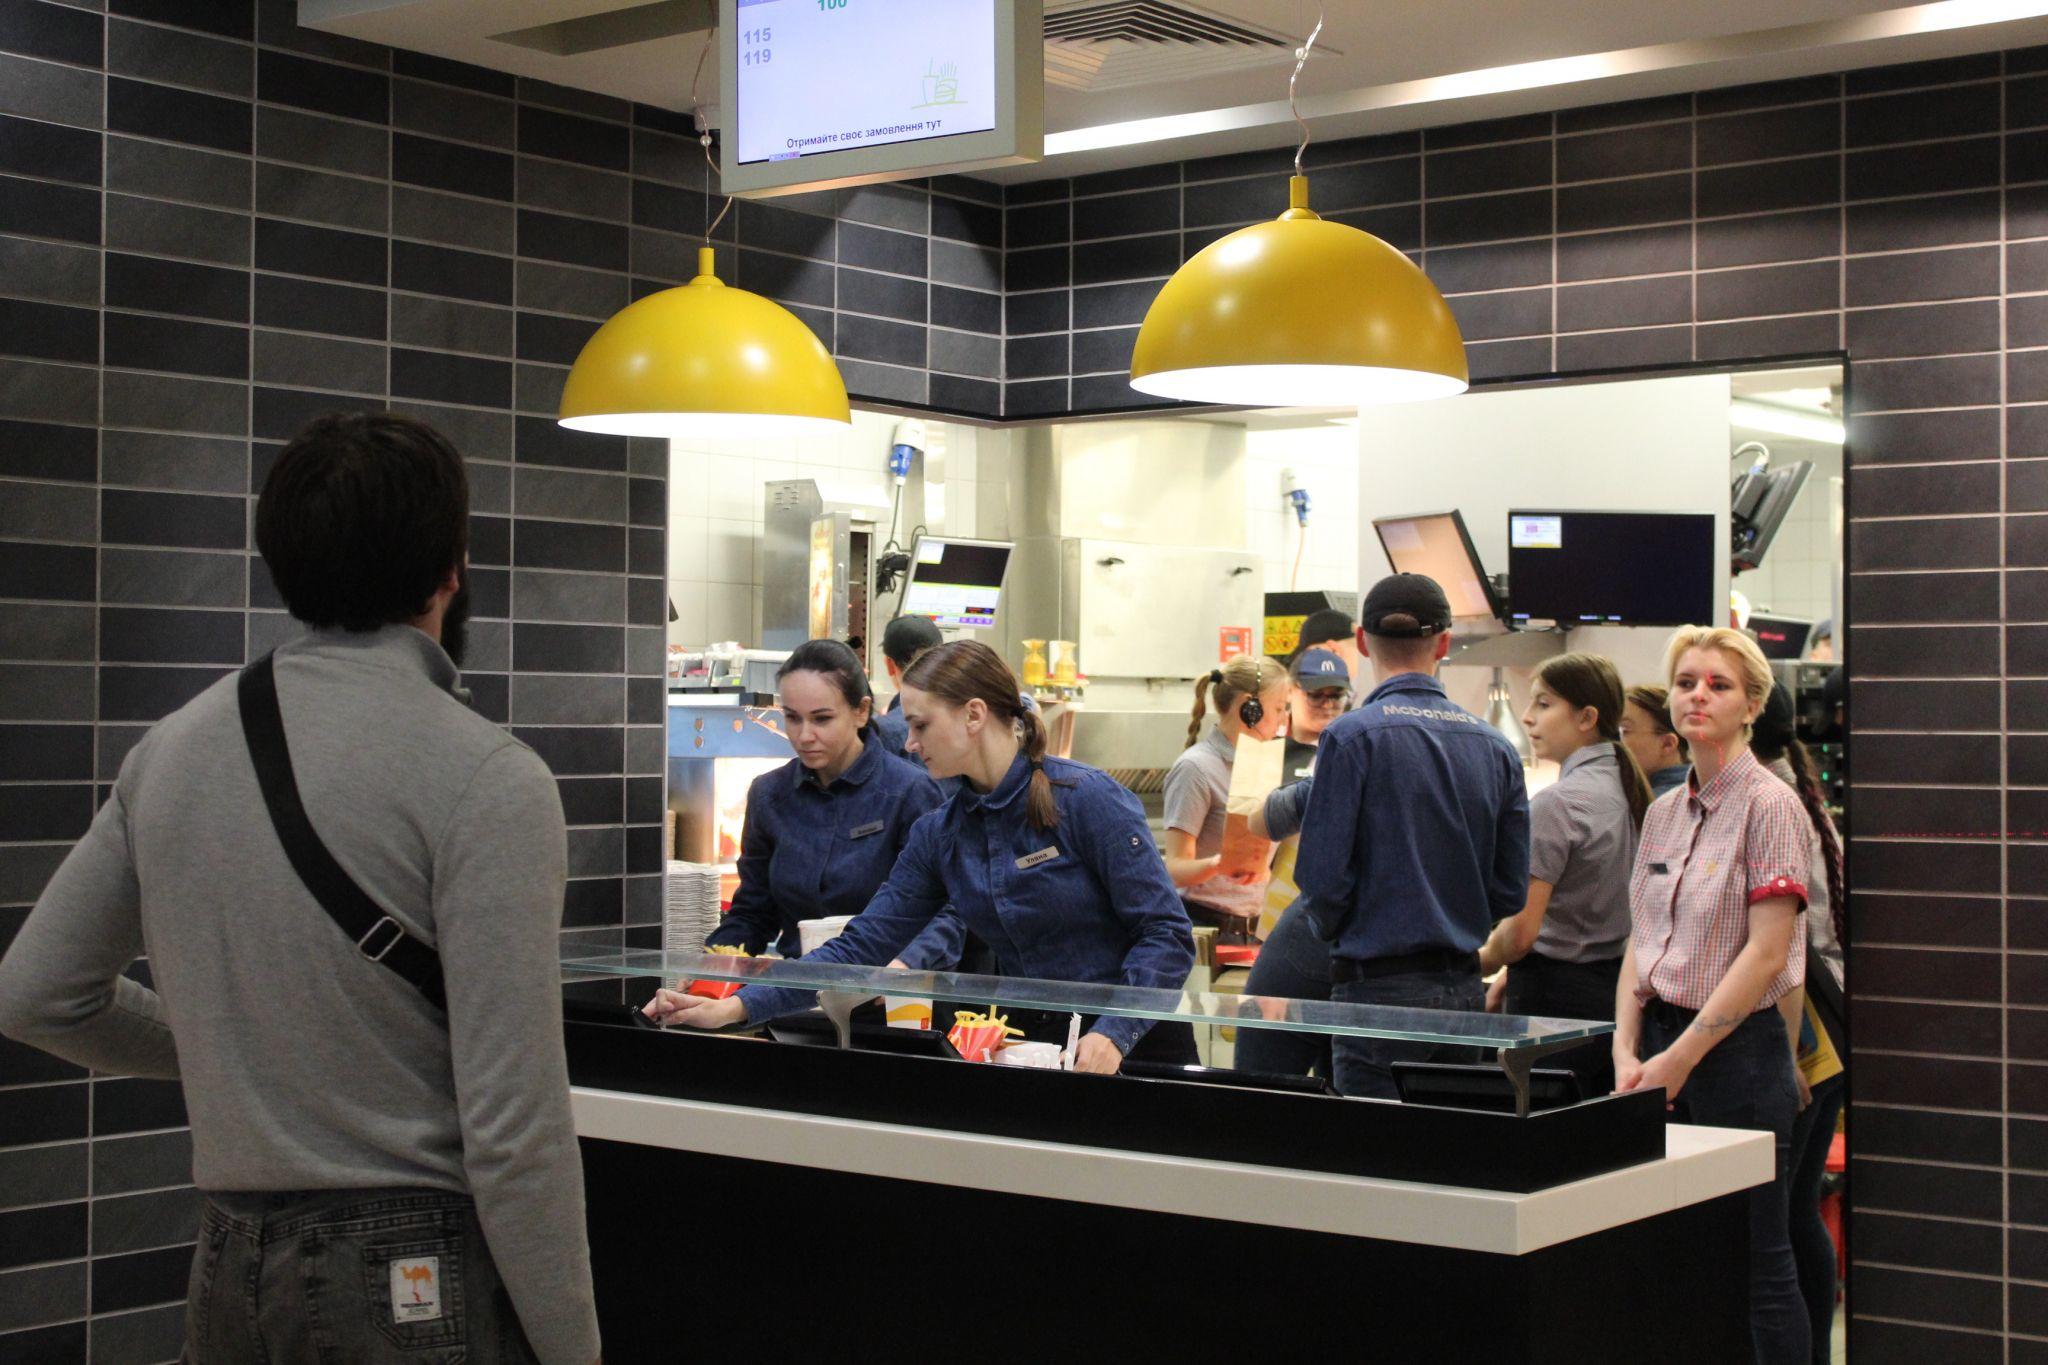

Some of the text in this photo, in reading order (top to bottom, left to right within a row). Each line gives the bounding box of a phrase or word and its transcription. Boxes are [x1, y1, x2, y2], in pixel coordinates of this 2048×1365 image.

[744, 27, 771, 44] 115
[744, 49, 771, 65] 119
[786, 120, 942, 148] Отримайте своє замовлення тут
